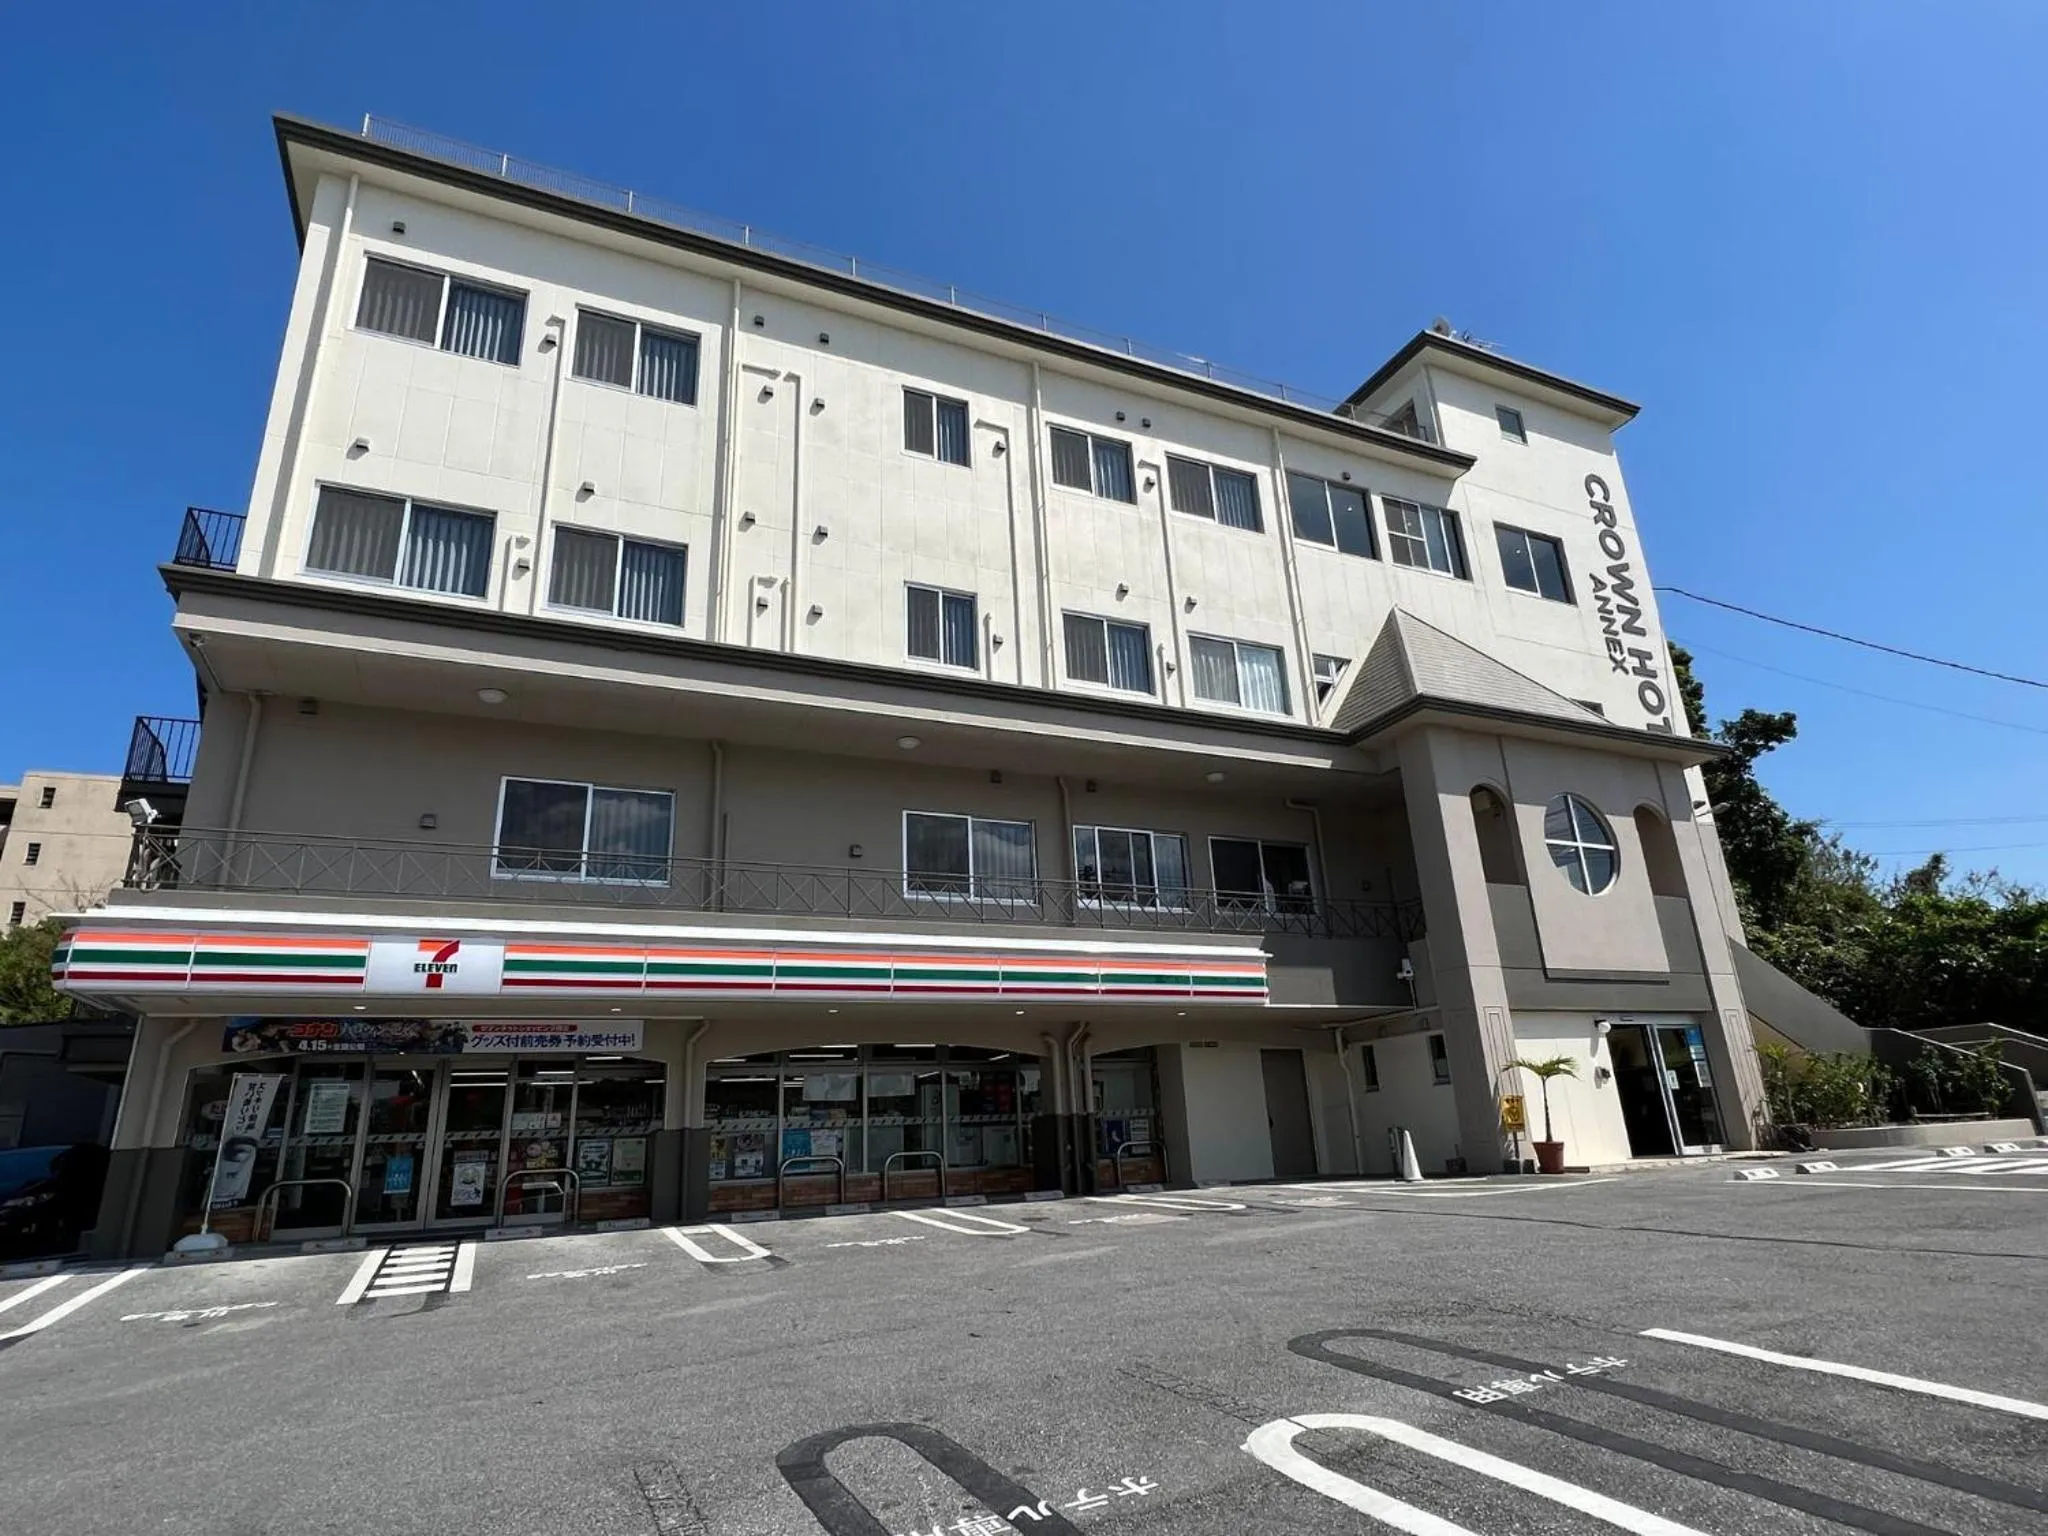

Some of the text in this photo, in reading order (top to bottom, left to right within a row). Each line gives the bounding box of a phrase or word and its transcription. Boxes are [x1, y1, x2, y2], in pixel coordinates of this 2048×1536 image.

[1584, 473, 1647, 637] CROWN
[1588, 573, 1630, 676] ANNEX
[418, 939, 460, 988] 7
[470, 1034, 562, 1048] グッズ付前売券
[889, 1476, 1159, 1536] ホテル車
